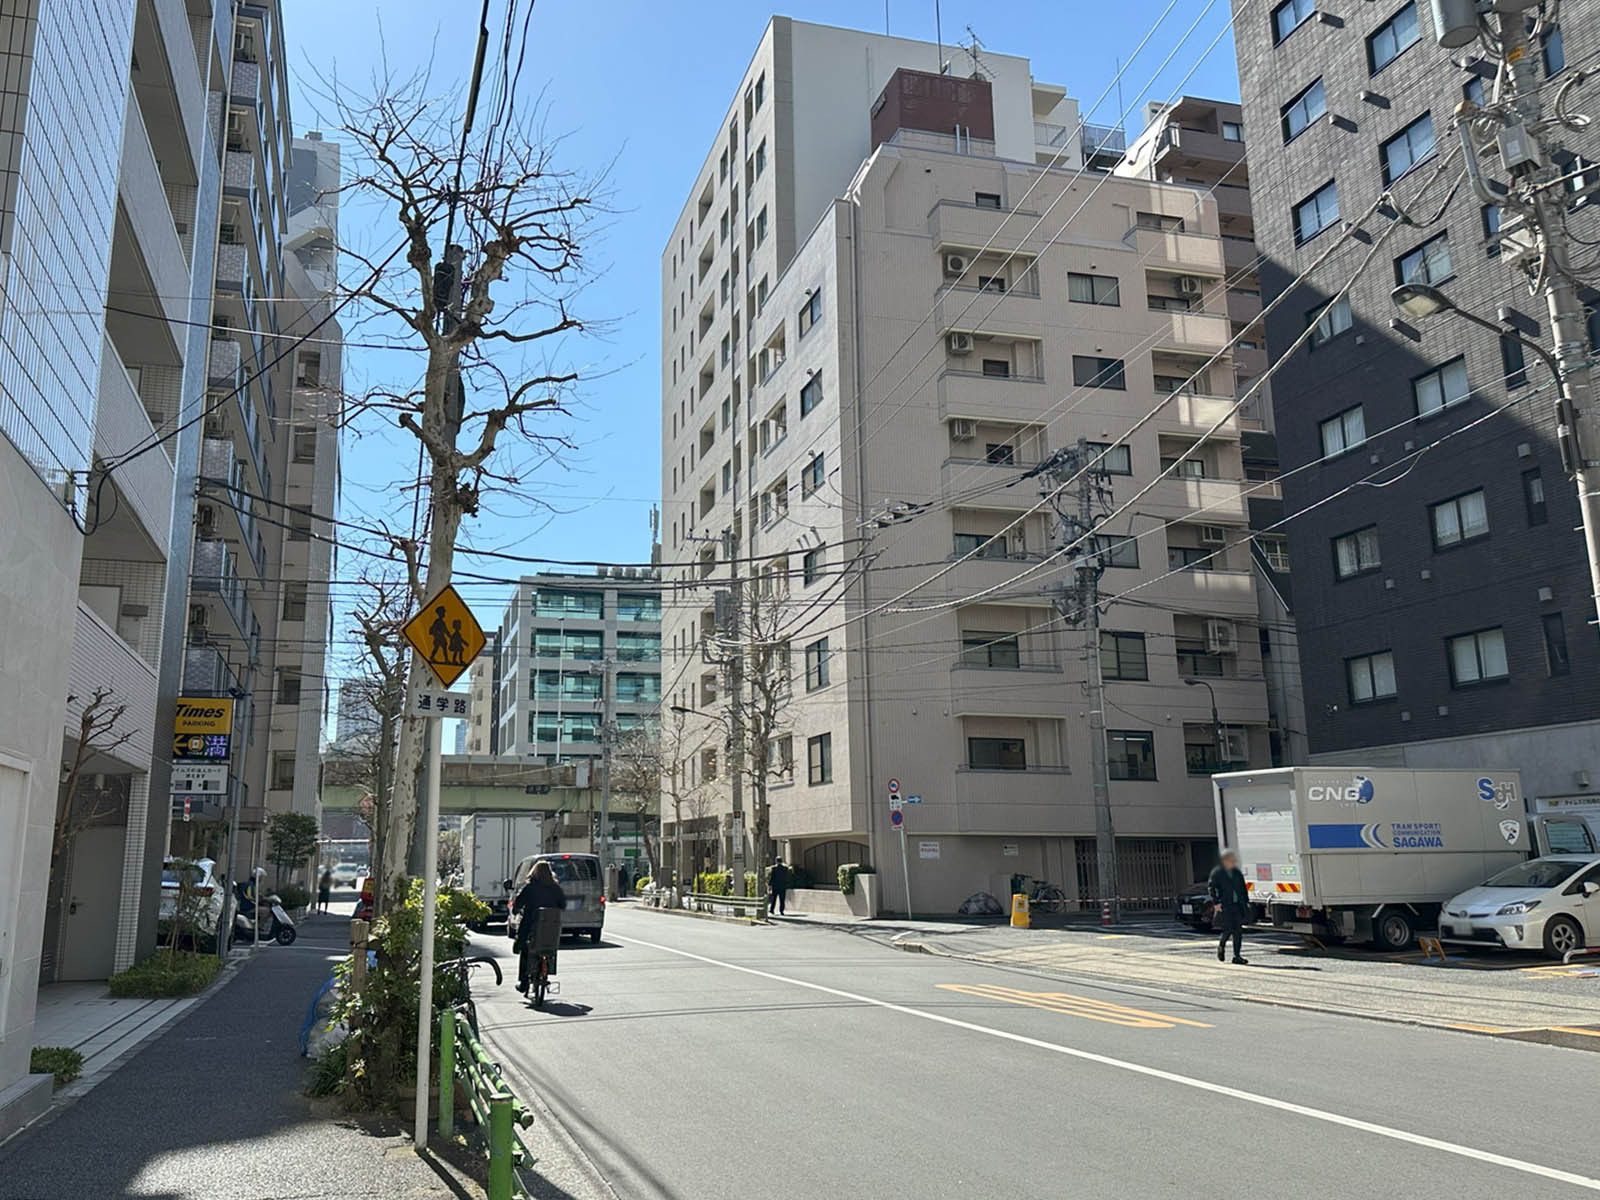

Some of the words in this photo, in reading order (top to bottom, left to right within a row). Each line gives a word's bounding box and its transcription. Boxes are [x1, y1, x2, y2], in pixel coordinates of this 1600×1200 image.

[176, 704, 225, 718] Times
[418, 694, 466, 714] 通学路
[205, 735, 228, 757] 満
[1308, 786, 1360, 801] CNG
[1393, 836, 1443, 848] SAGAWA
